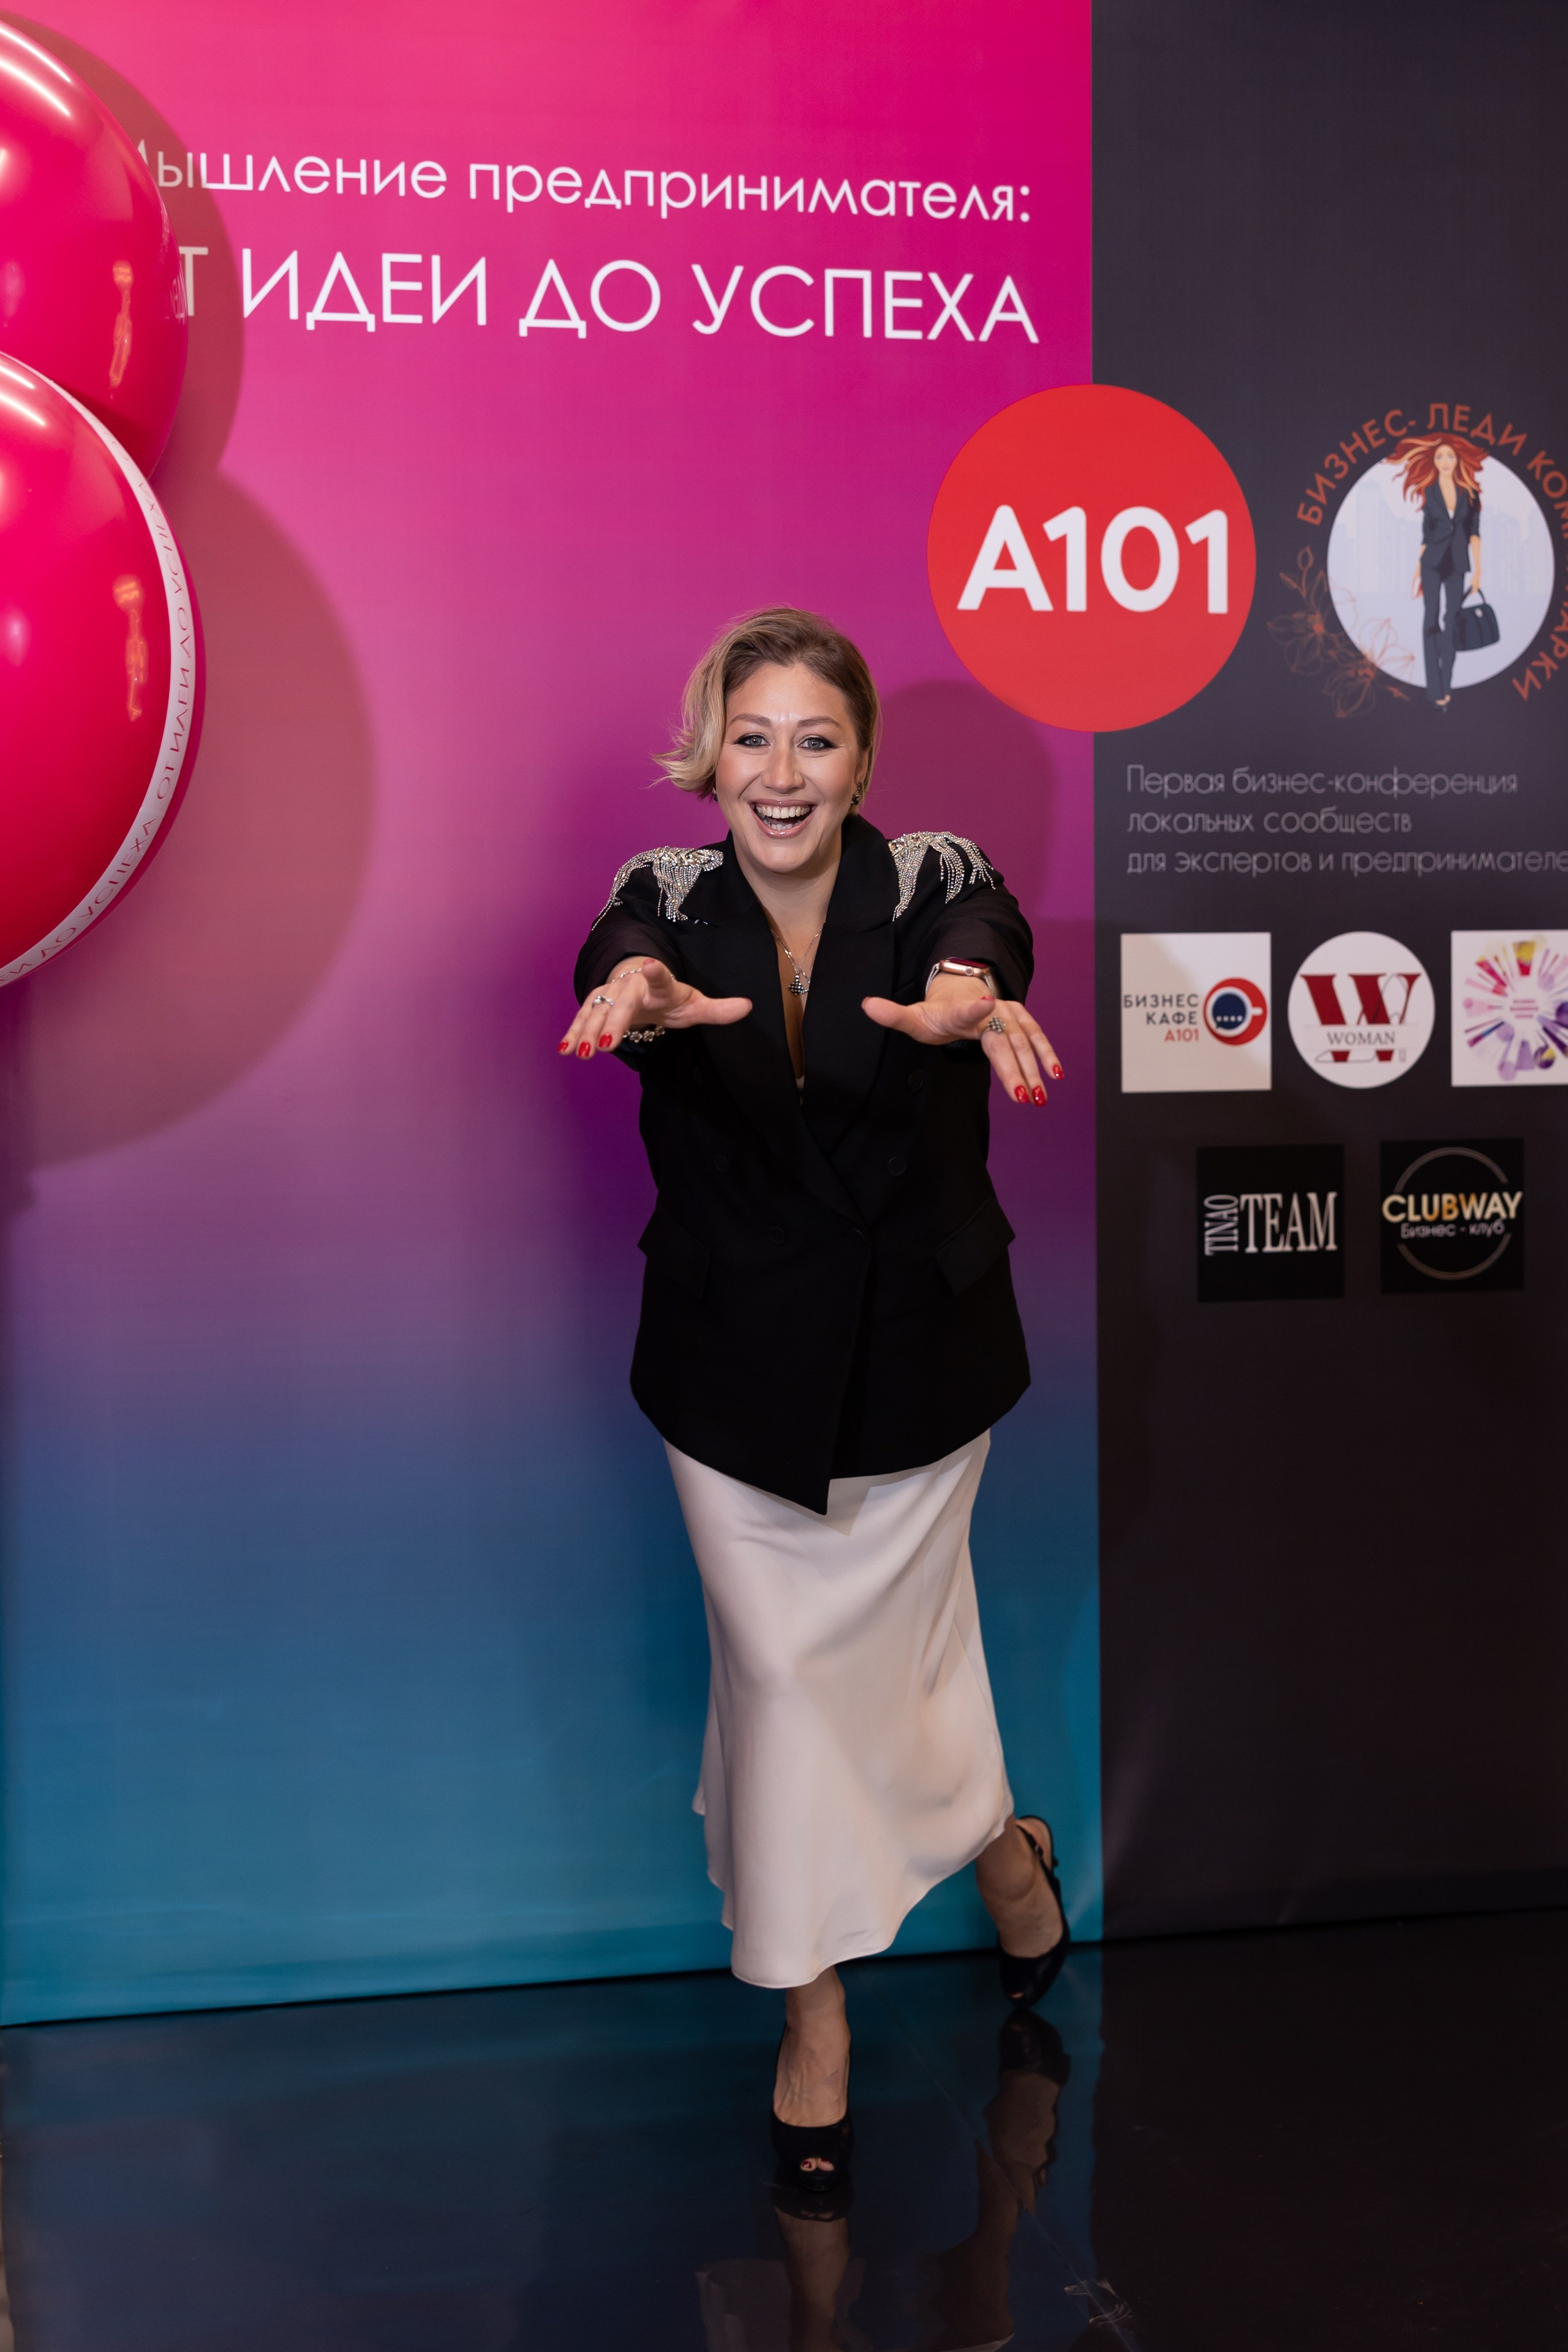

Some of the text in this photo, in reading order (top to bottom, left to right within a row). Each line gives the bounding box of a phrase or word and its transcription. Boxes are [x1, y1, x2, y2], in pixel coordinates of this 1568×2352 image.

[469, 164, 1030, 222] предпринимателя:
[178, 246, 1039, 344] Т ИДЕИ ДО УСПЕХА
[1427, 403, 1528, 456] ЛЕДИ
[956, 504, 1229, 615] А101
[1126, 764, 1518, 800] Первая бизнес-конференция
[1126, 805, 1412, 834] локальных сообществ
[1126, 852, 1167, 874] для
[1174, 851, 1313, 878] экспертов
[1319, 853, 1334, 871] и
[1123, 993, 1199, 1008] БИЗНЕС
[1146, 1011, 1198, 1025] КАФЕ
[1164, 1028, 1199, 1042] А101
[1327, 1030, 1396, 1045] WOMAN
[1381, 1191, 1523, 1224] CLUBWAY
[1203, 1191, 1338, 1256] TINAO TEAM
[1401, 1223, 1457, 1239] Бизнес
[1469, 1218, 1505, 1237] клуб
